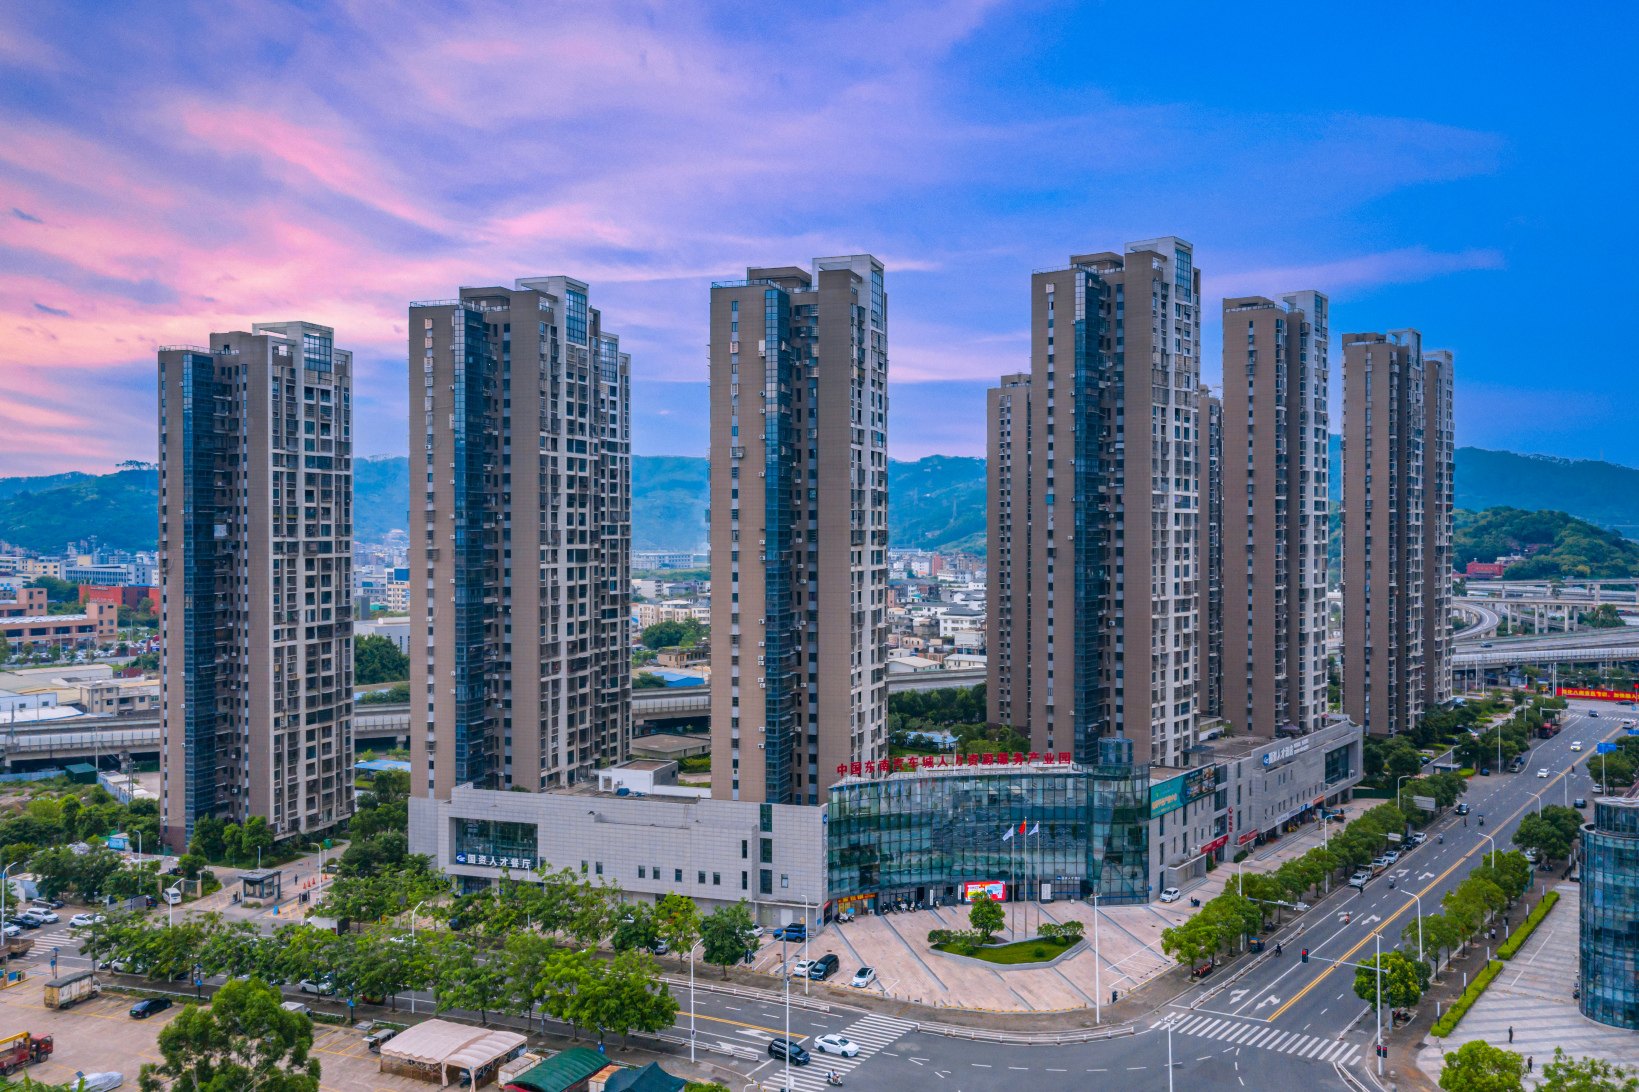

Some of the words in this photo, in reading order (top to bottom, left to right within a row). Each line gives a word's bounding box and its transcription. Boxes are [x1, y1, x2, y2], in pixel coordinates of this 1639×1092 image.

[836, 752, 1071, 777] 中国东南汽车城人力资源服务产业园
[467, 854, 531, 869] 国资人才餐厅
